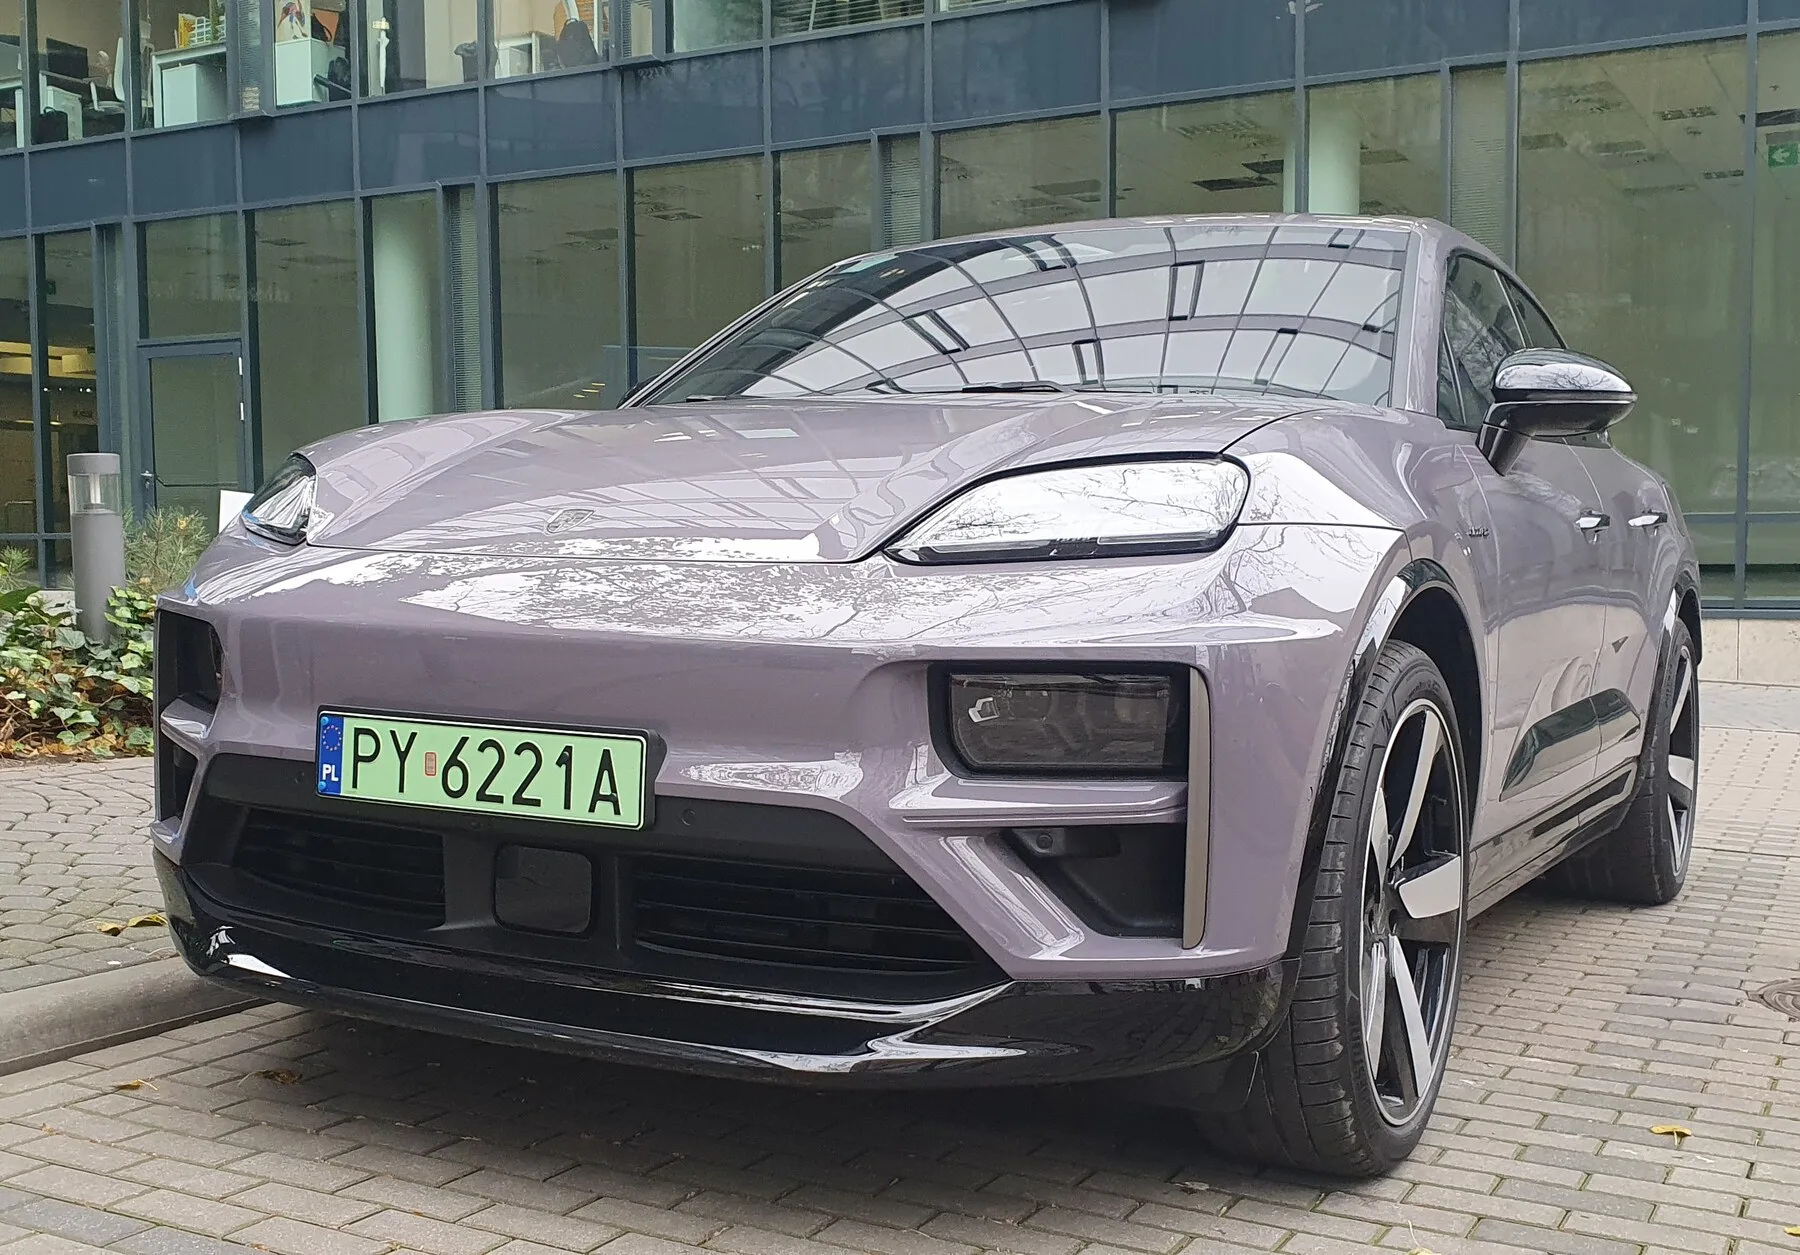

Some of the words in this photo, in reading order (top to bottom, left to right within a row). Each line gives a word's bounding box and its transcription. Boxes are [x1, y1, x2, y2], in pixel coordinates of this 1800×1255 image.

[322, 764, 339, 782] PL
[352, 727, 418, 794] PY
[441, 736, 621, 816] 6221A
